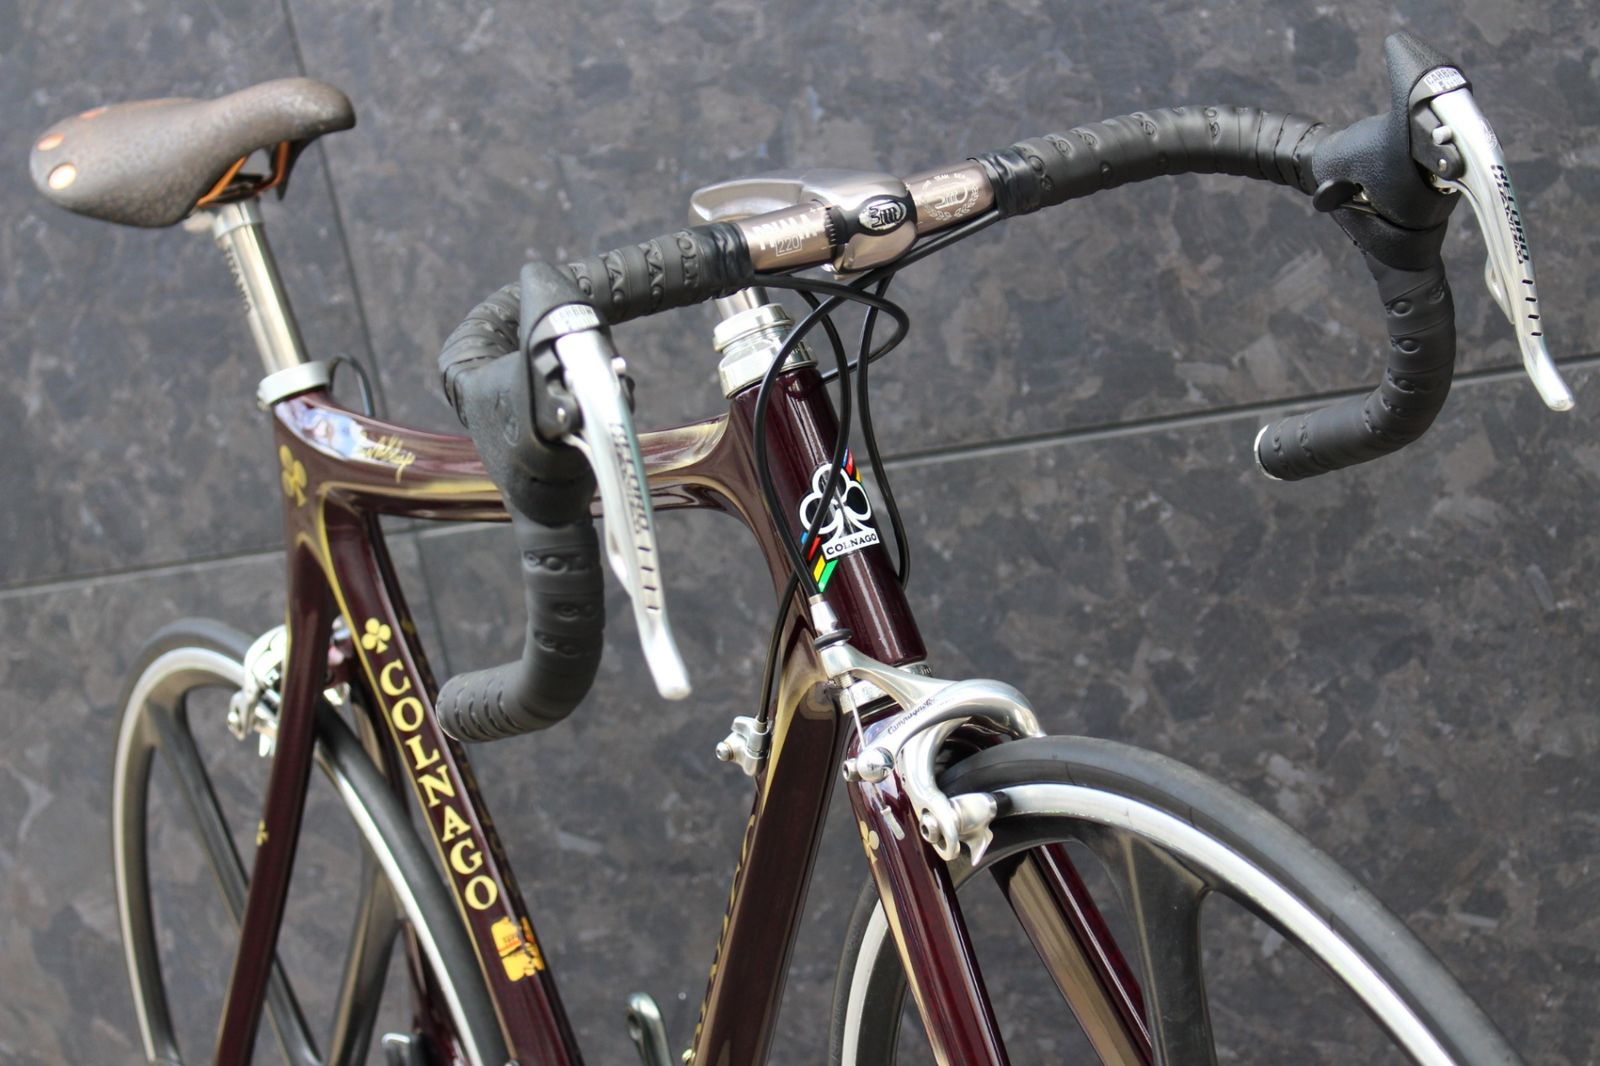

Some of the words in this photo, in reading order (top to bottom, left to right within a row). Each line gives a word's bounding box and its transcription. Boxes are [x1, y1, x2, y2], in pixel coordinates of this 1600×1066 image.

[777, 236, 800, 253] 220
[826, 532, 877, 555] COLNAGO
[379, 659, 498, 910] COLNAGO
